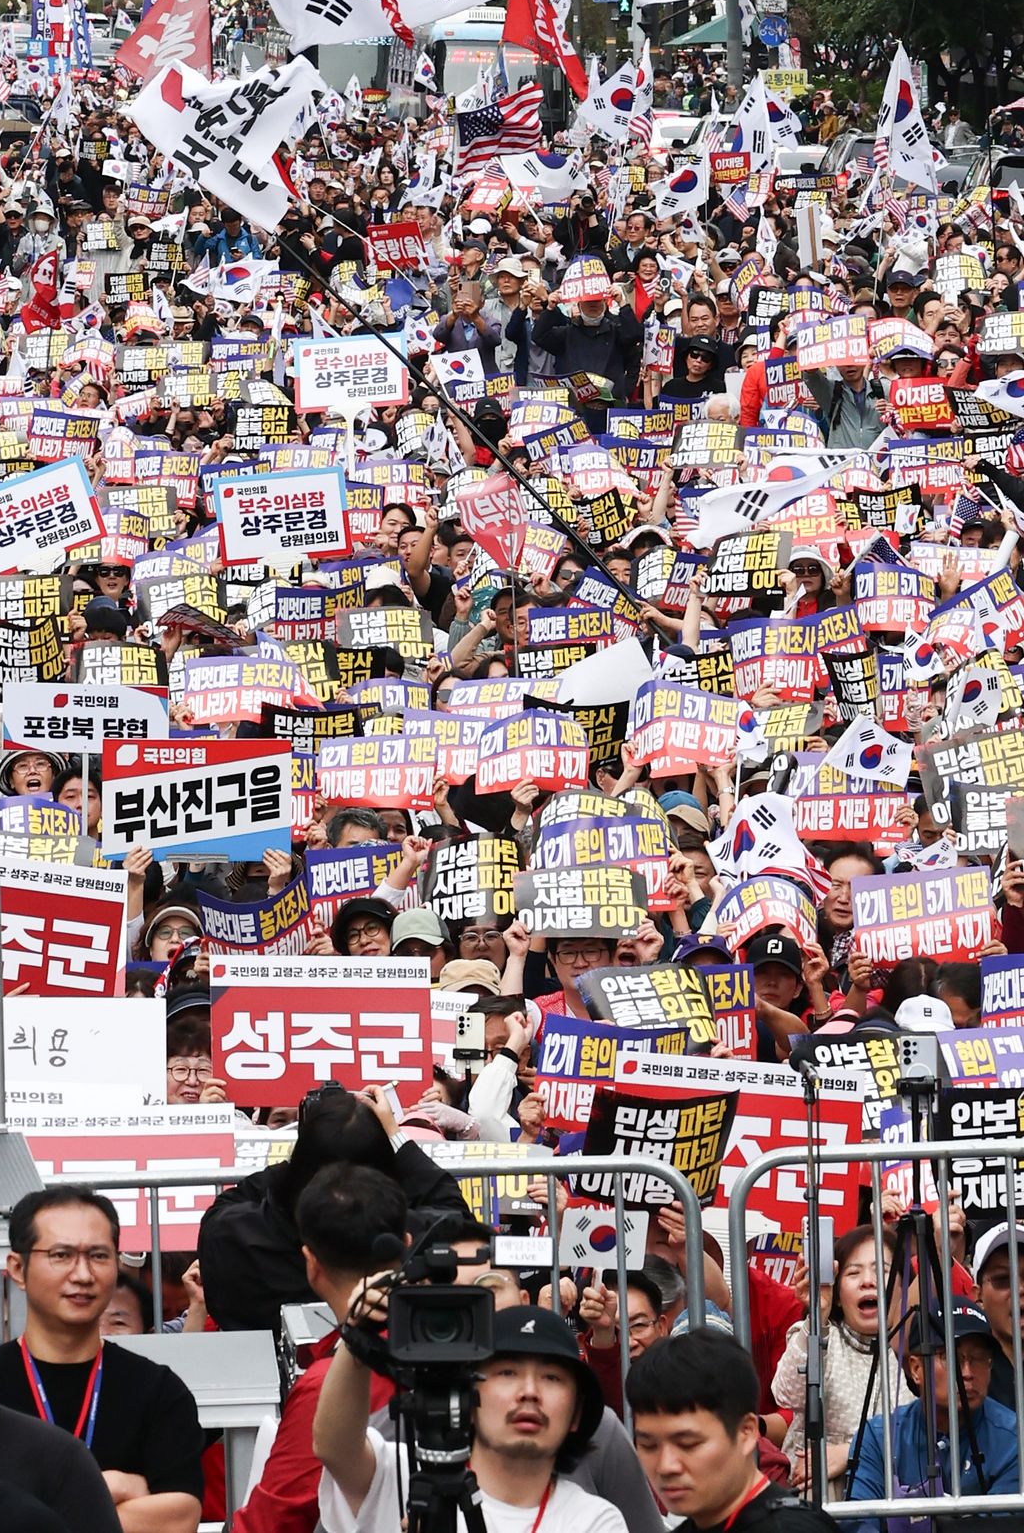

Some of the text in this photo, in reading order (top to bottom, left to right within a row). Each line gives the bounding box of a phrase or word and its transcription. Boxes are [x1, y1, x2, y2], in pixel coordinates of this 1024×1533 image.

[314, 347, 340, 355] 국민의힘
[314, 352, 388, 371] 보수의심장
[315, 367, 388, 388] 상주문경
[347, 385, 397, 398] 당원협의회
[894, 384, 945, 405] 이재명
[237, 408, 288, 423] 안보참사
[237, 486, 267, 495] 국민의힘
[238, 491, 325, 515] 보수의심장
[36, 519, 93, 549] 당원협의회
[240, 510, 328, 537] 상주문경
[280, 531, 340, 548] 당원협의회
[718, 531, 780, 556] 민생파탄
[714, 550, 777, 574] 사법파괴
[82, 645, 157, 668] 민생파탄
[187, 661, 294, 692] 제멋대로 농지조사
[73, 695, 119, 709] 국민의힘
[23, 717, 148, 740] 포항북 당협
[144, 746, 206, 766] 국민의힘
[525, 750, 556, 780] 재판
[558, 750, 586, 780] 재개
[320, 765, 434, 796] 이재명 재판 재개
[113, 765, 282, 843] 부산진구을
[435, 838, 519, 872] 민생파탄
[542, 824, 666, 868] 12개 혐의 5개 재판
[75, 878, 124, 894] 당원협의회
[312, 855, 368, 895] 제멋대로
[533, 870, 632, 888] 민생파탄
[533, 885, 633, 907] 사법파괴
[855, 873, 989, 927] 12개 혐의 5개 재판
[203, 886, 308, 944] 제멋대로 농지조사
[518, 907, 594, 932] 이재명
[859, 911, 992, 964] 이재명 재판 재개
[230, 966, 269, 978] 국민의힘
[376, 967, 428, 980] 당원협의회
[601, 967, 701, 1001] 안보참사
[221, 1009, 424, 1082] 성주군
[544, 1032, 616, 1076] 12개 혐의
[642, 1063, 683, 1077] 국민의힘
[615, 1103, 725, 1138] 민생파탄
